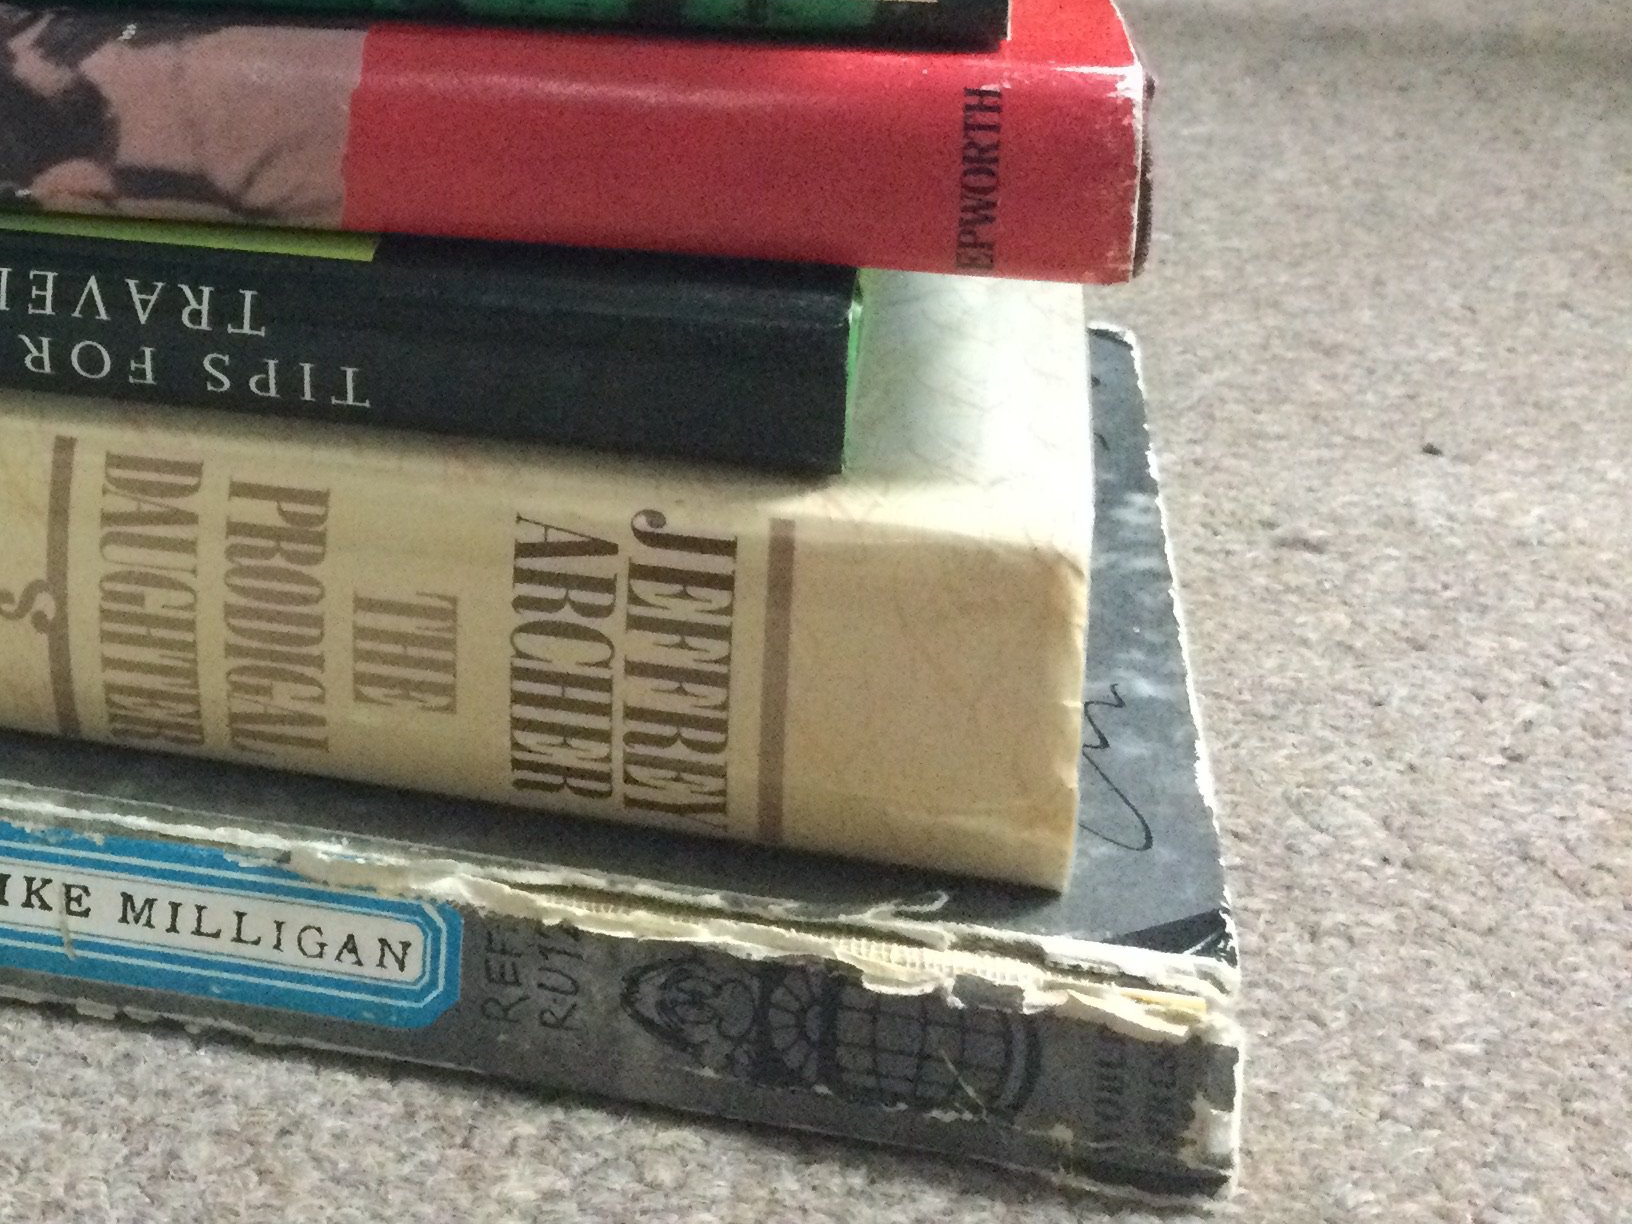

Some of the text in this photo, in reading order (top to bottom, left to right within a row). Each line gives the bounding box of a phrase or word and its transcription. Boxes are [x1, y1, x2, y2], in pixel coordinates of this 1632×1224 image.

[955, 88, 1003, 270] EPWORTH
[17, 334, 157, 385] FOR
[201, 352, 371, 408] TIPS
[98, 451, 206, 745] DAUGHTER
[223, 476, 331, 754] PRODIGAL
[353, 589, 459, 715] THE
[508, 511, 620, 802] ARCHER
[622, 507, 739, 833] JEFFREY
[117, 891, 413, 973] MILLIGAN
